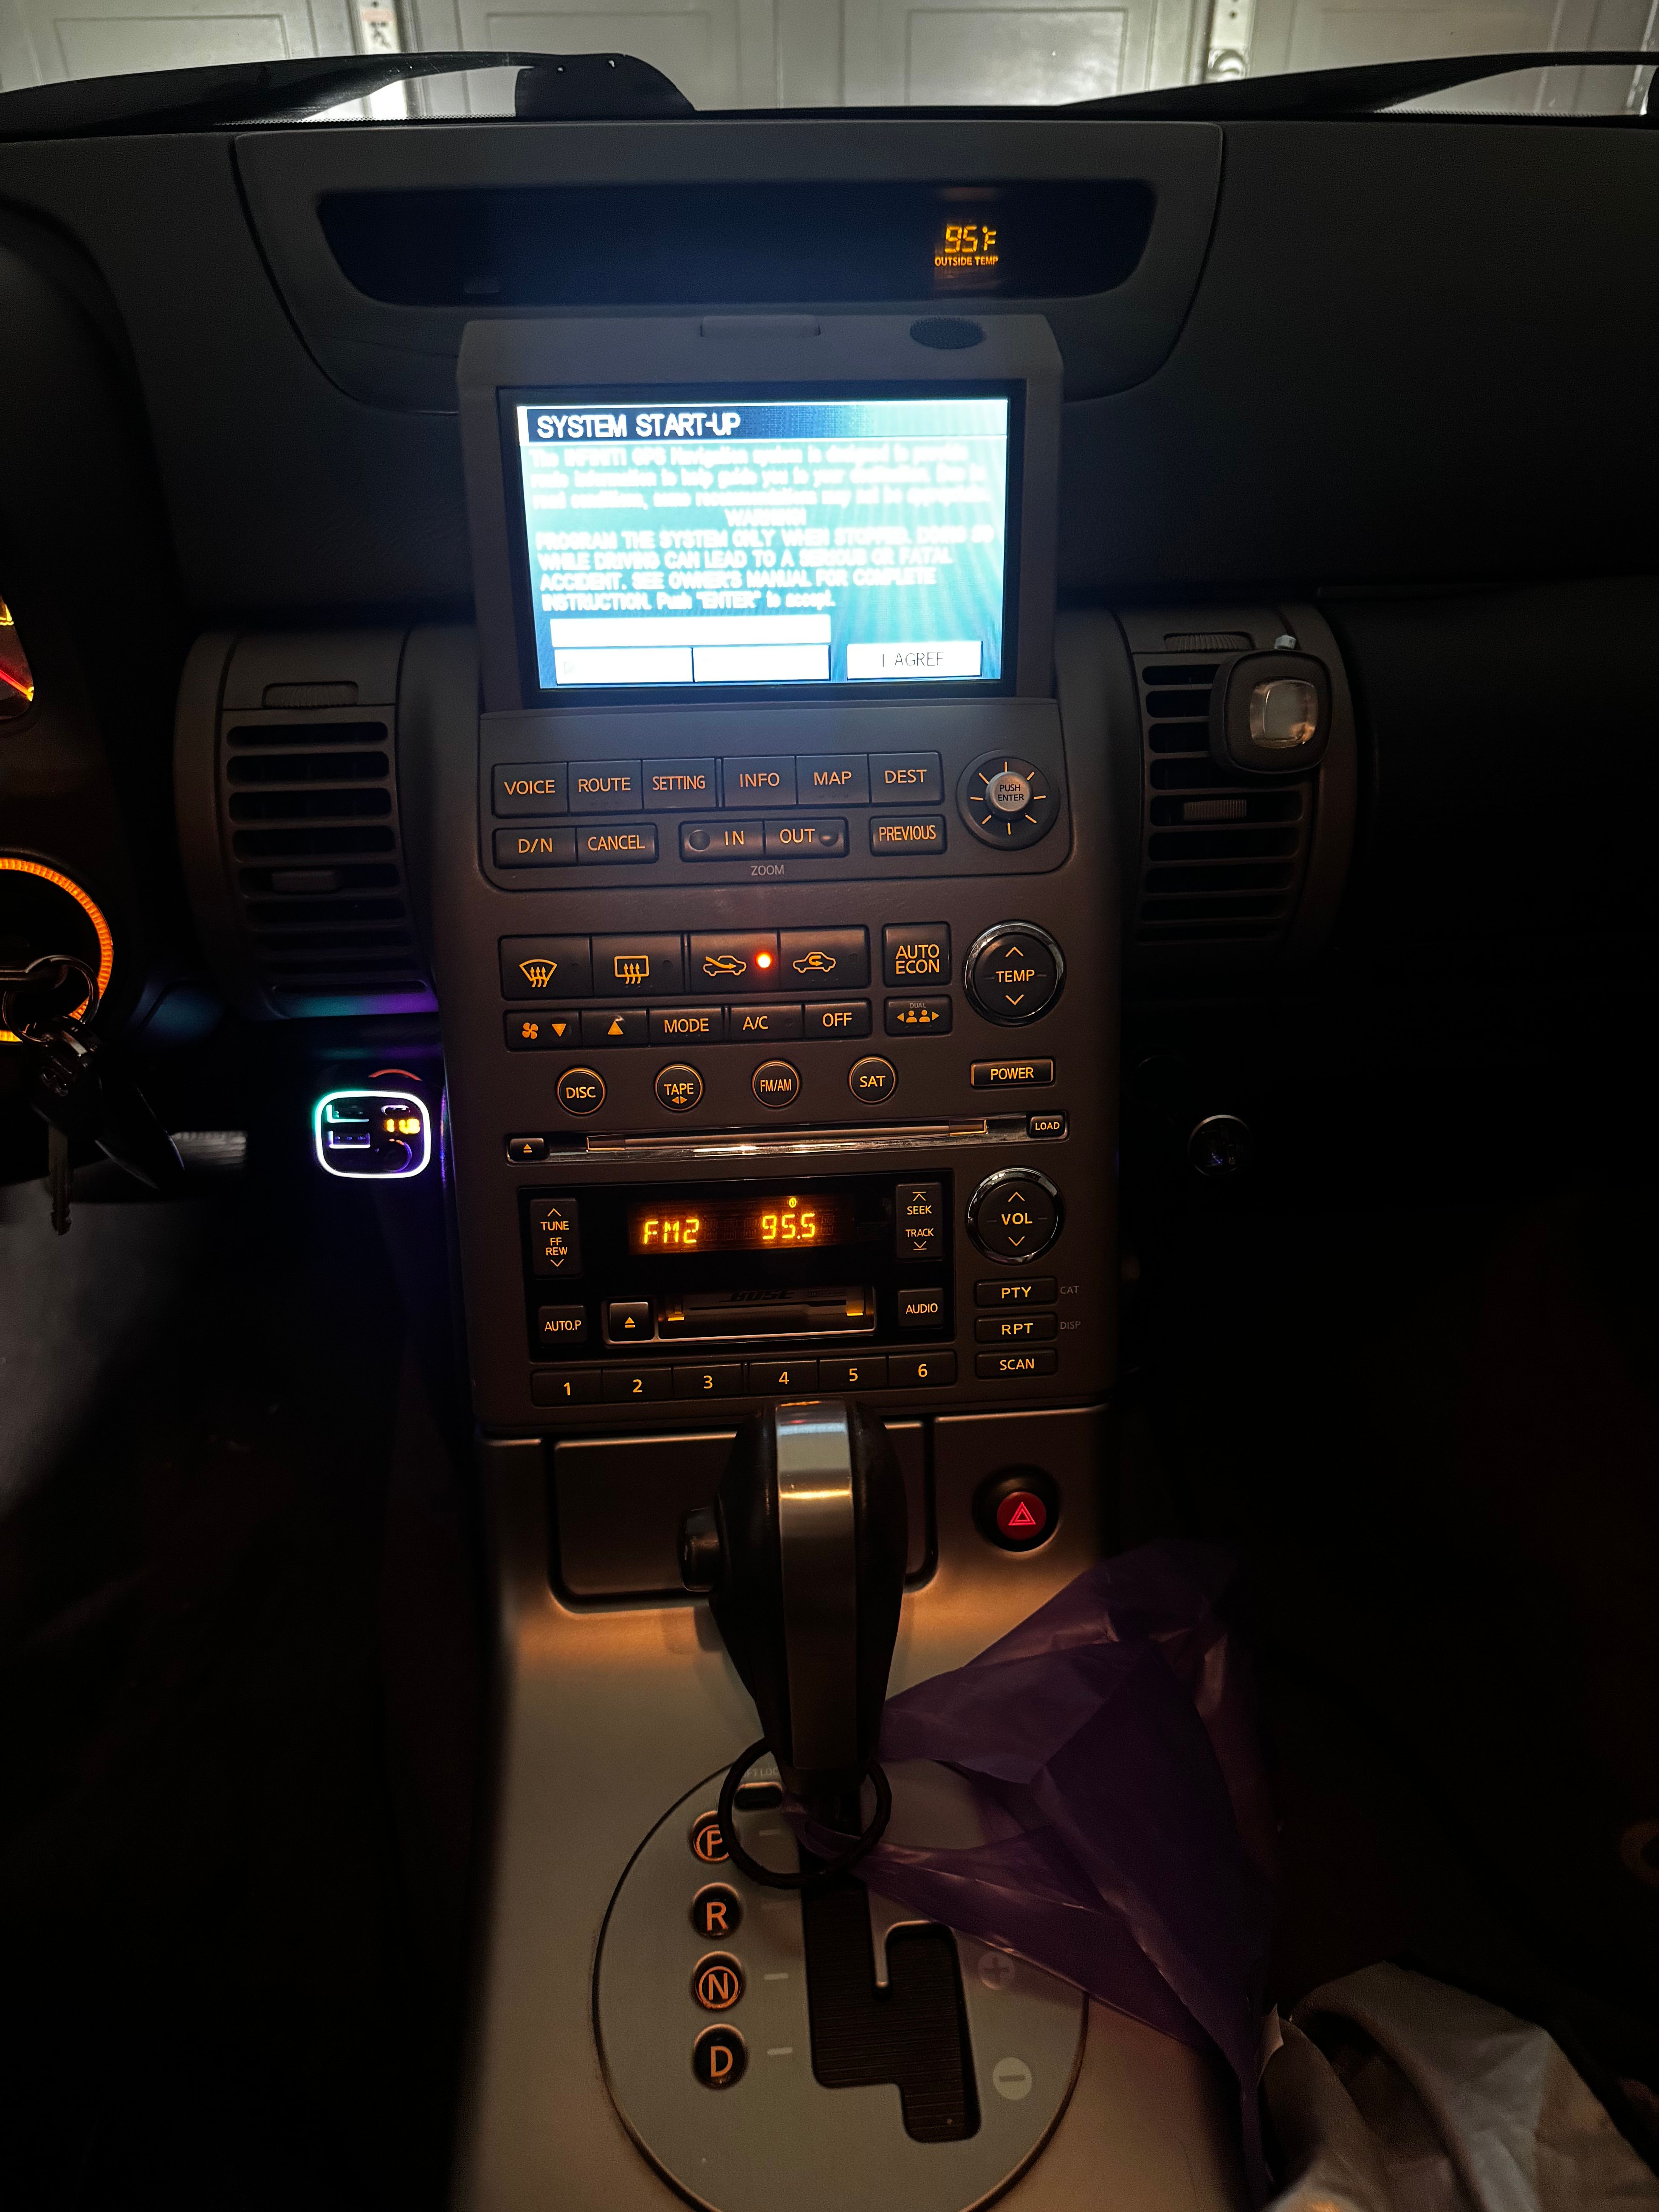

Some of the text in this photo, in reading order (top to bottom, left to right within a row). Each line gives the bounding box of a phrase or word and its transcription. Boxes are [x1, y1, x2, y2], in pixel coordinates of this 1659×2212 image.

[934, 255, 999, 266] OUTSIDE TEMP
[537, 413, 741, 438] SYSTEM START-UP
[536, 531, 617, 550] PROGRAM
[622, 530, 655, 549] THE
[659, 529, 728, 548] SYSTEM
[732, 528, 776, 548] ONLY
[781, 528, 830, 546] WHEN
[537, 552, 591, 570] WHILE
[594, 551, 660, 570] DRIVING
[665, 550, 700, 569] CAN
[704, 550, 747, 568] LEAD
[752, 549, 776, 567] TO
[781, 548, 794, 567] A
[899, 546, 953, 565] FATAL
[541, 567, 936, 591] ACCIDENT. SEE OWNER'S MANUAL FOR COMPLETE
[895, 652, 944, 667] AGREE
[652, 775, 706, 791] SETTING
[740, 772, 780, 788] INFO
[814, 771, 852, 785] MAP
[884, 769, 927, 784] DEST
[504, 779, 555, 795] VOICE
[578, 777, 631, 793] ROUTE
[999, 783, 1021, 792] PUSH
[998, 793, 1025, 802] ENTER
[725, 830, 745, 846] IN
[779, 828, 815, 843] OUT
[879, 825, 936, 842] PREVIOUS
[518, 838, 553, 854] D/N
[587, 834, 646, 851] CANCEL
[750, 864, 785, 876] ZOOM
[895, 943, 940, 960] AUTO
[895, 959, 940, 975] ECON
[995, 969, 1035, 983] TEMP
[664, 1018, 709, 1033] MODE
[742, 1015, 768, 1031] A/C
[822, 1012, 852, 1027] OFF
[990, 1066, 1034, 1080] POWER
[760, 1079, 792, 1092] FM/AM
[859, 1075, 886, 1088] SAT
[566, 1086, 596, 1099] DISC
[664, 1083, 694, 1096] TAPE
[1035, 1121, 1060, 1131] LOAD
[907, 1205, 932, 1215] SEEK
[1001, 1212, 1033, 1225] VOL
[540, 1221, 570, 1231] TUNE
[643, 1212, 815, 1244] FM2 95.5
[905, 1227, 934, 1238] TRACK
[550, 1237, 562, 1246] FF
[546, 1246, 568, 1256] REW
[1001, 1285, 1080, 1298] PTY CAT
[905, 1303, 938, 1314] AUDIO
[544, 1320, 582, 1331] AUTO.P
[1001, 1321, 1081, 1335] RPT DISP
[917, 1364, 928, 1377] 6
[1000, 1358, 1034, 1371] SCAN
[703, 1375, 713, 1389] 3
[778, 1371, 790, 1385] 4
[848, 1368, 858, 1382] 5
[563, 1382, 571, 1396] 1
[632, 1379, 643, 1393] 2
[706, 1901, 728, 1931] R
[708, 1972, 729, 2001] N
[710, 2045, 733, 2077] D
